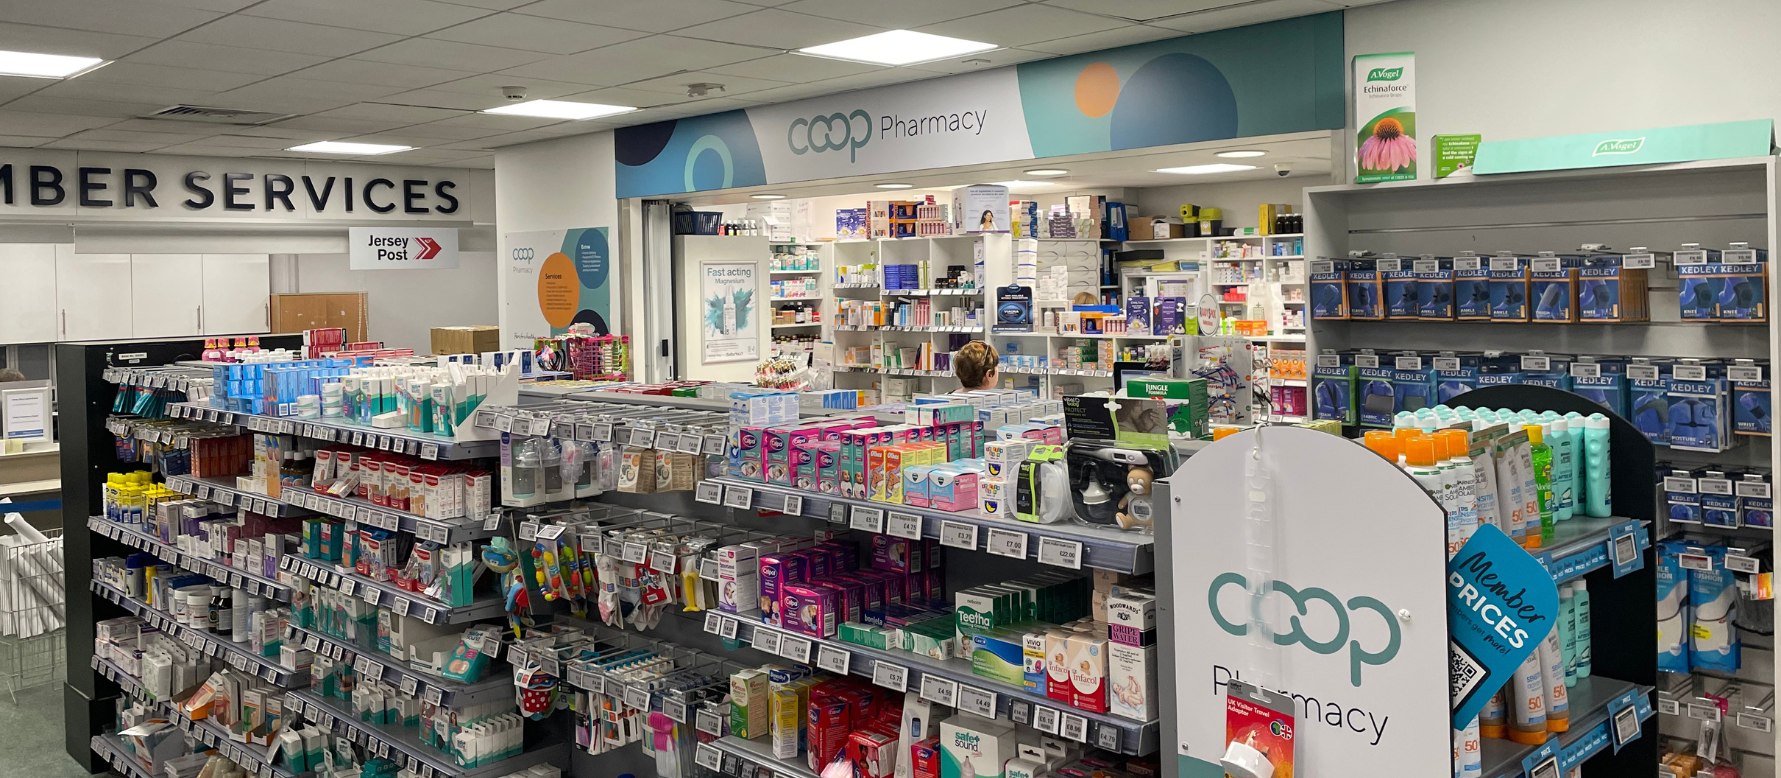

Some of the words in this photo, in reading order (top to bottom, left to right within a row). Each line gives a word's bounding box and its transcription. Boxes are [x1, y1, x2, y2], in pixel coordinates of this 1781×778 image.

[1370, 69, 1400, 79] A.Vogel
[1364, 84, 1407, 93] Echinaforce
[787, 109, 872, 164] coop
[881, 109, 987, 140] Pharmacy
[1601, 141, 1637, 151] A.Vogel
[184, 169, 459, 214] SERVICES
[368, 234, 409, 249] Jersey
[378, 249, 408, 261] Post
[513, 266, 533, 274] Pharmacy
[707, 267, 726, 277] Fast
[727, 268, 752, 277] acting
[1457, 269, 1488, 277] KEDLEY
[1581, 267, 1616, 276] KEDLEY
[1681, 265, 1718, 274] KEDLEY
[1720, 264, 1759, 273] KEDLEY
[1317, 367, 1347, 376] KEDLEY
[1361, 368, 1392, 377] KEDLEY
[1395, 373, 1426, 381] KEDLEY
[1478, 375, 1513, 384] KEDLEY
[1576, 376, 1613, 385] KEDLEY
[1145, 383, 1168, 392] JUNGLE
[1634, 378, 1666, 388] KEDLE
[1670, 383, 1711, 393] KEDLEY
[1526, 501, 1538, 514] 50
[957, 532, 972, 540] £3.79
[1006, 540, 1022, 549] £7.00
[1059, 550, 1075, 558] £22.00
[762, 566, 776, 576] Calpol
[1458, 551, 1546, 623] Member
[784, 597, 798, 608] Calpol
[1449, 571, 1529, 649] PRICES
[864, 614, 883, 626] bonjela
[958, 610, 990, 627] Teetha
[1113, 624, 1138, 637] GRIPE
[1208, 571, 1401, 687] coop
[1113, 632, 1138, 645] WATER
[1471, 622, 1485, 636] get
[1483, 633, 1511, 656] more!
[1049, 663, 1068, 675] infaco
[1073, 672, 1097, 685] infacol
[937, 687, 952, 696] £4.59
[1553, 685, 1564, 699] 50
[975, 697, 990, 707] £4.49
[1213, 664, 1389, 746] Pmacy
[1528, 696, 1541, 710] 50
[1227, 705, 1249, 717] Adaptor
[1228, 698, 1236, 706] UK
[1236, 701, 1253, 712] Visitor
[1253, 707, 1270, 718] Travel
[1100, 733, 1115, 742] £4.79
[955, 740, 979, 752] sound
[1464, 740, 1477, 751] 50
